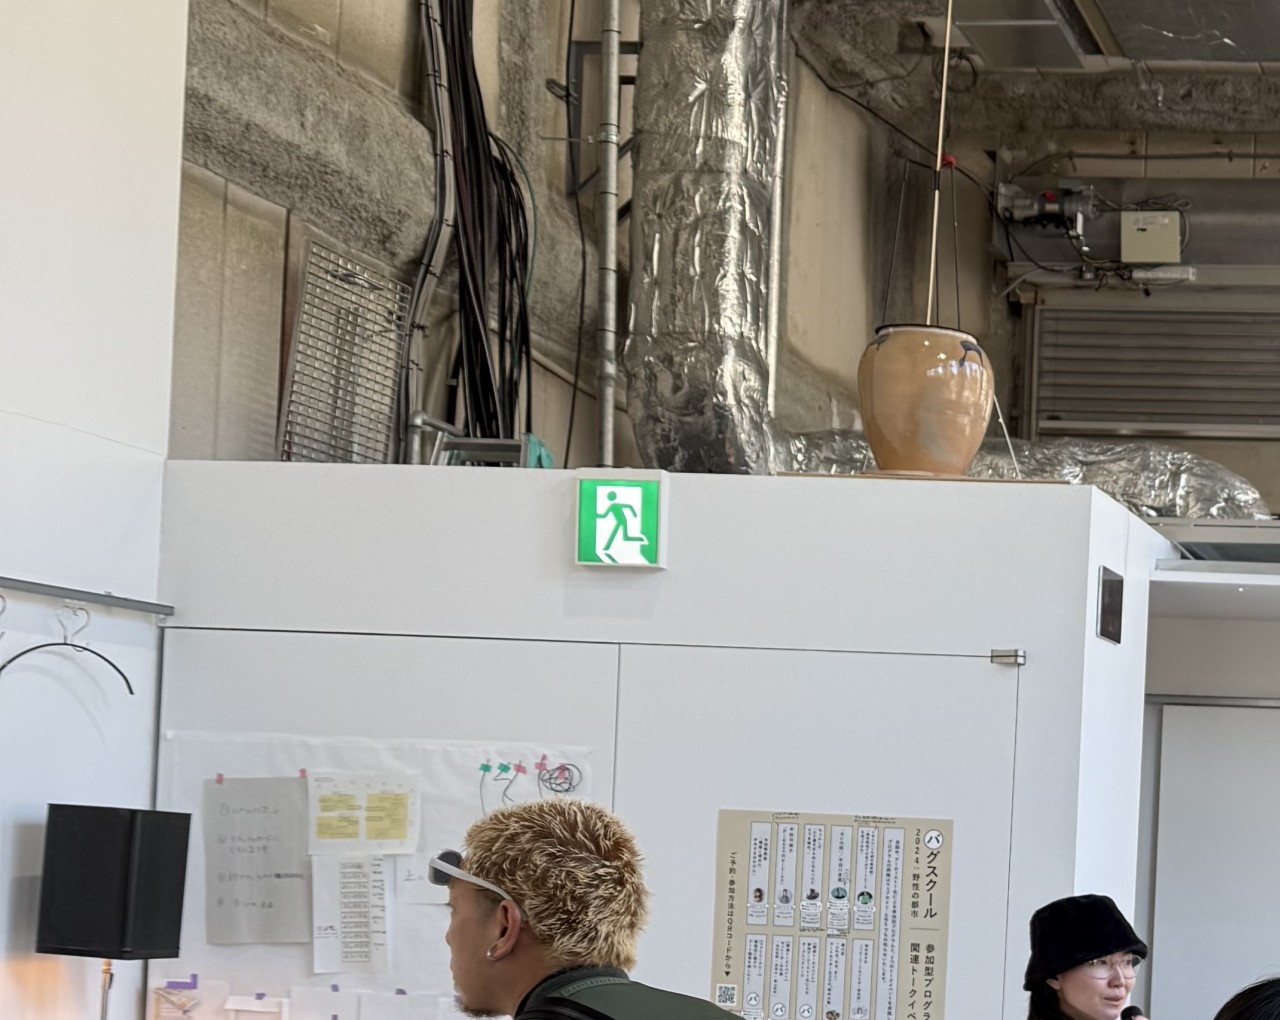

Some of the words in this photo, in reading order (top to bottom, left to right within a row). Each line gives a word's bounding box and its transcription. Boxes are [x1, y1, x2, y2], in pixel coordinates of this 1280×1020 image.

[924, 832, 941, 918] バグスクール
